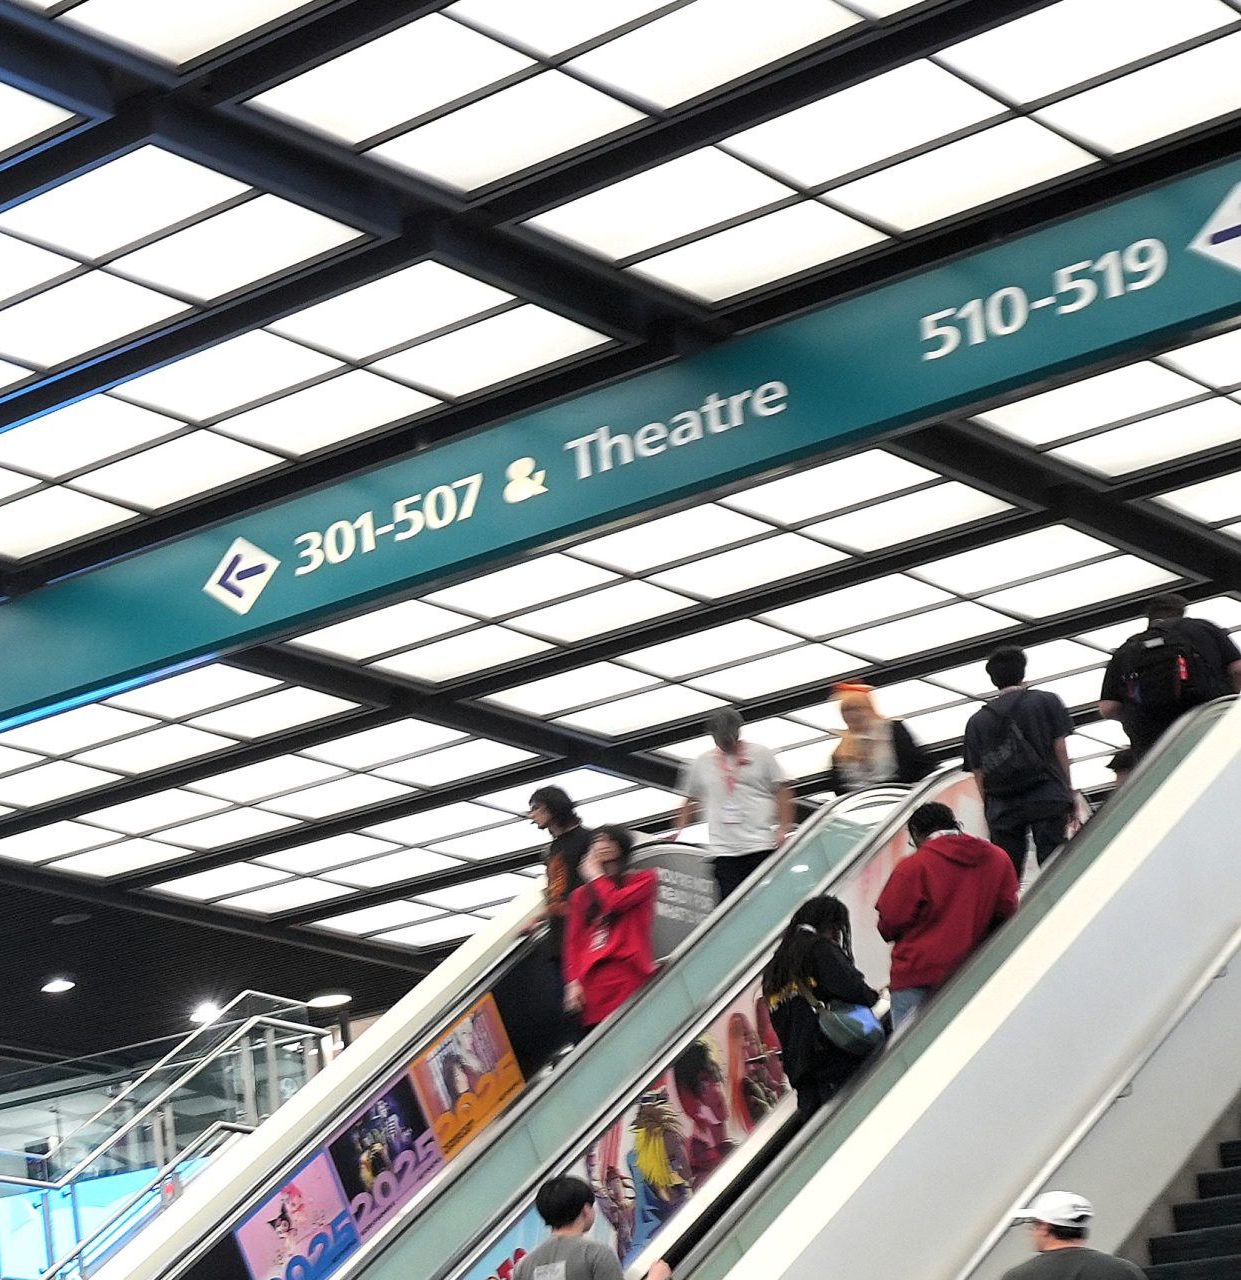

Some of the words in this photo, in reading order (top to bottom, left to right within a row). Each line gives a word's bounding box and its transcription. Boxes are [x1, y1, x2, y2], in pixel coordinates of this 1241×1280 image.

[920, 238, 1167, 361] 510-519
[294, 472, 483, 577] 301-507
[502, 456, 549, 504] &
[563, 380, 789, 480] Theatre
[351, 1127, 437, 1223] 2025
